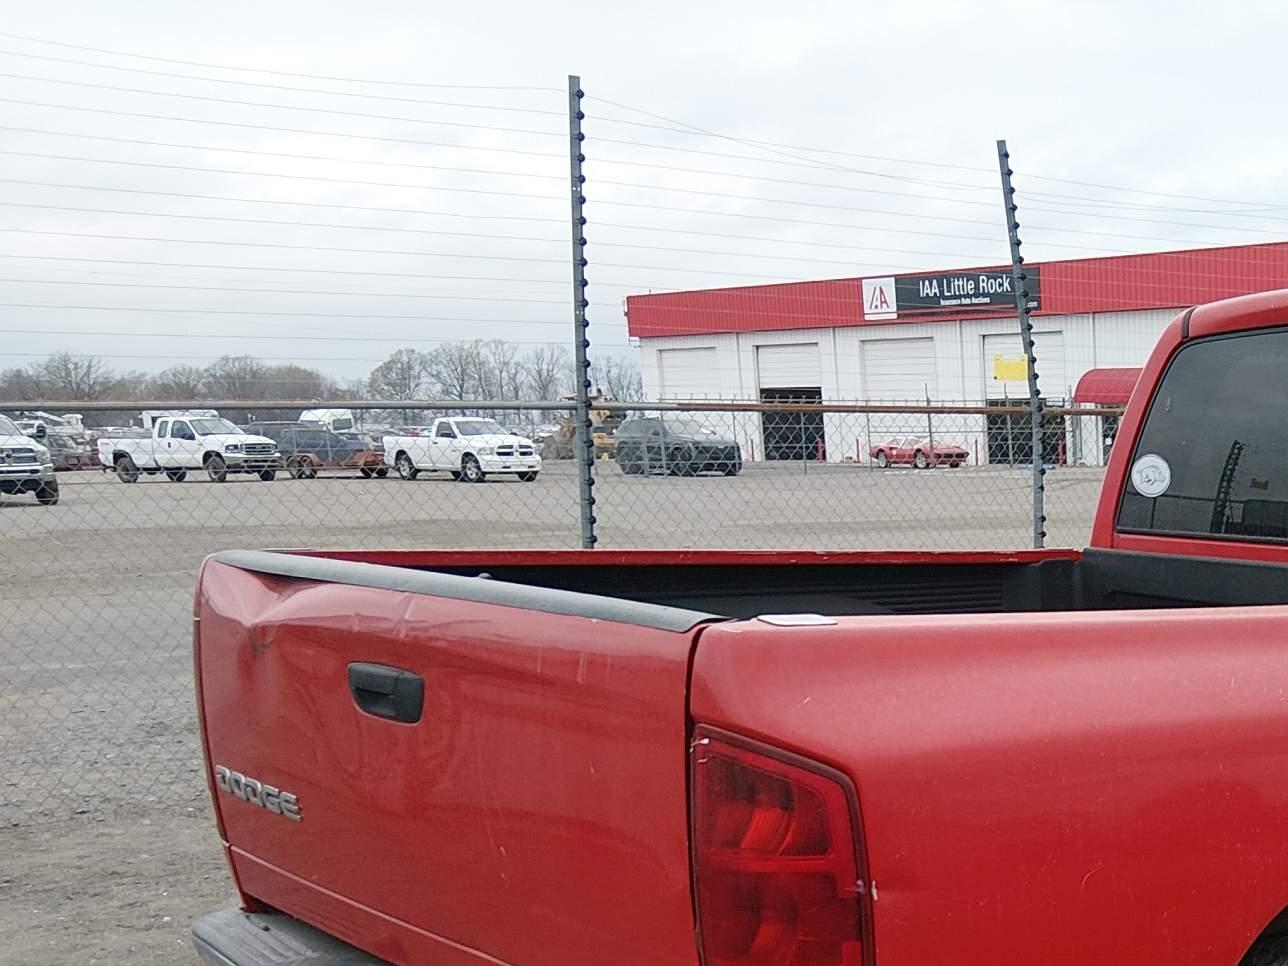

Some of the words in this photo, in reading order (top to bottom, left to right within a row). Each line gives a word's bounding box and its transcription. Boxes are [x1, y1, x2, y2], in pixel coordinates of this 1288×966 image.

[920, 279, 940, 297] IAA
[944, 277, 975, 296] Little
[979, 274, 1011, 293] Rock
[215, 765, 302, 822] DODGE
